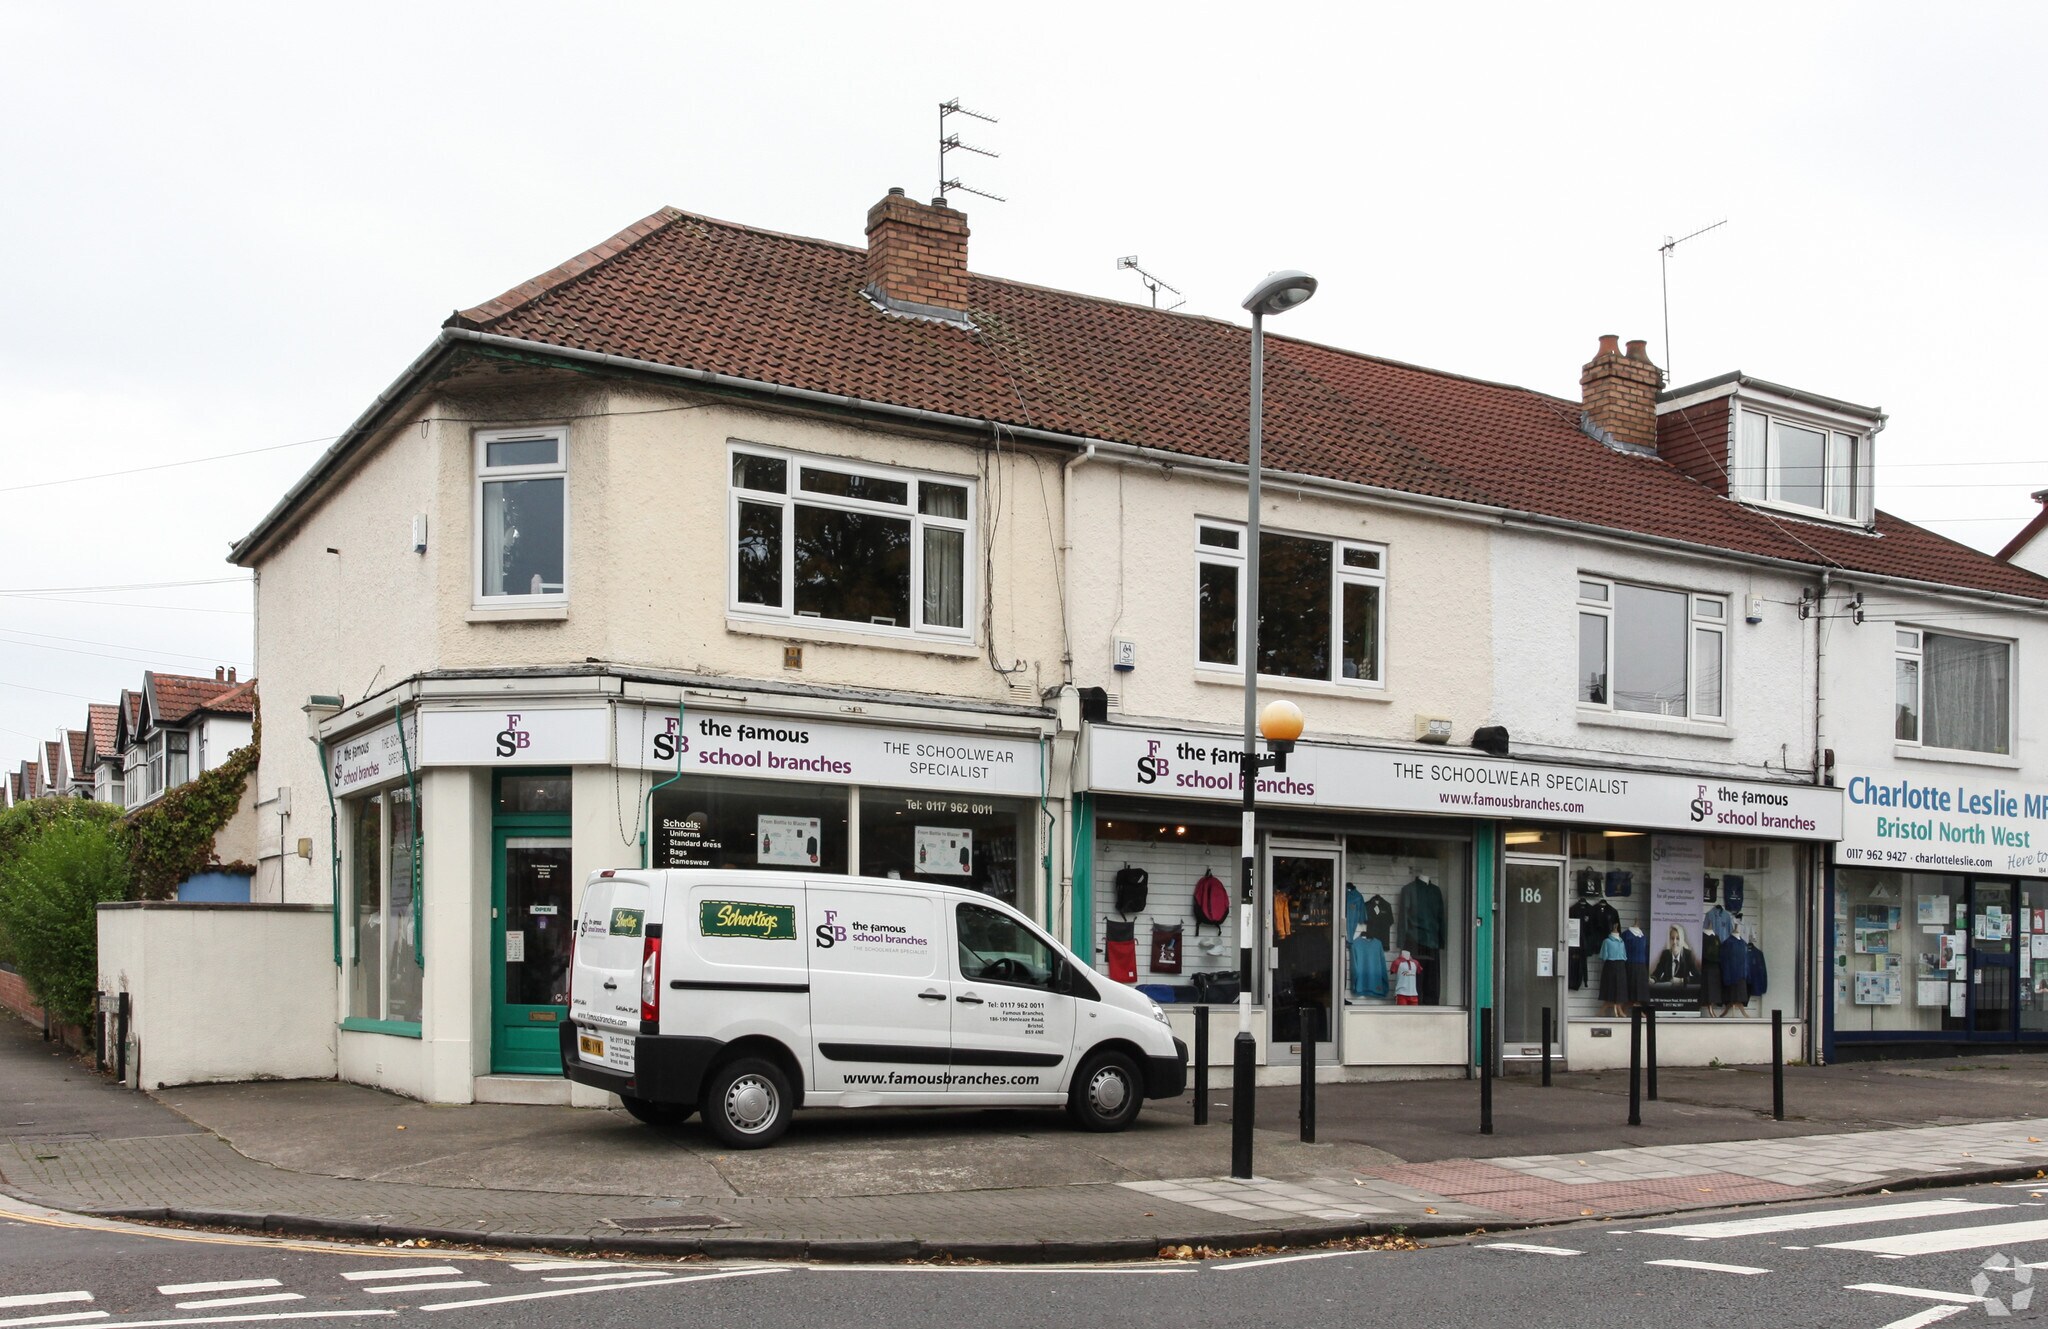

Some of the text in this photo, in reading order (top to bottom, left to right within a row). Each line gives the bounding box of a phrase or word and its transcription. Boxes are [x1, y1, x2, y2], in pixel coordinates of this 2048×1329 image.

[699, 719, 809, 744] the famous
[352, 742, 370, 761] famous
[699, 747, 852, 774] school branches
[883, 741, 1014, 763] THE SCHOOLWEAR
[1176, 742, 1206, 761] the
[909, 762, 989, 779] SPECIALIST
[1393, 762, 1629, 795] THE SCHOOLWEAR SPECIALIST
[1176, 770, 1233, 791] school
[1439, 791, 1585, 814] www.famousbranches.com
[1718, 787, 1789, 807] the famous
[1848, 776, 1951, 812] Charlotte
[1957, 787, 2018, 818] Leslie
[906, 799, 994, 815] Tel: 0117 962 0011
[663, 818, 701, 831] Schools:
[1717, 809, 1816, 832] school branches
[669, 830, 701, 838] Uniforms
[1877, 817, 2030, 848] Bristol North West
[669, 839, 722, 849] Standard dress
[669, 848, 688, 857] Bags
[669, 857, 710, 866] Gameswear
[1846, 848, 1993, 867] 0117 962 9427 charlotteleslie.com
[2007, 853, 2034, 870] Here
[1519, 887, 1542, 904] 186
[851, 921, 906, 934] the famous
[852, 933, 928, 946] school branches
[843, 1071, 1040, 1086] www.famousbranches.com
